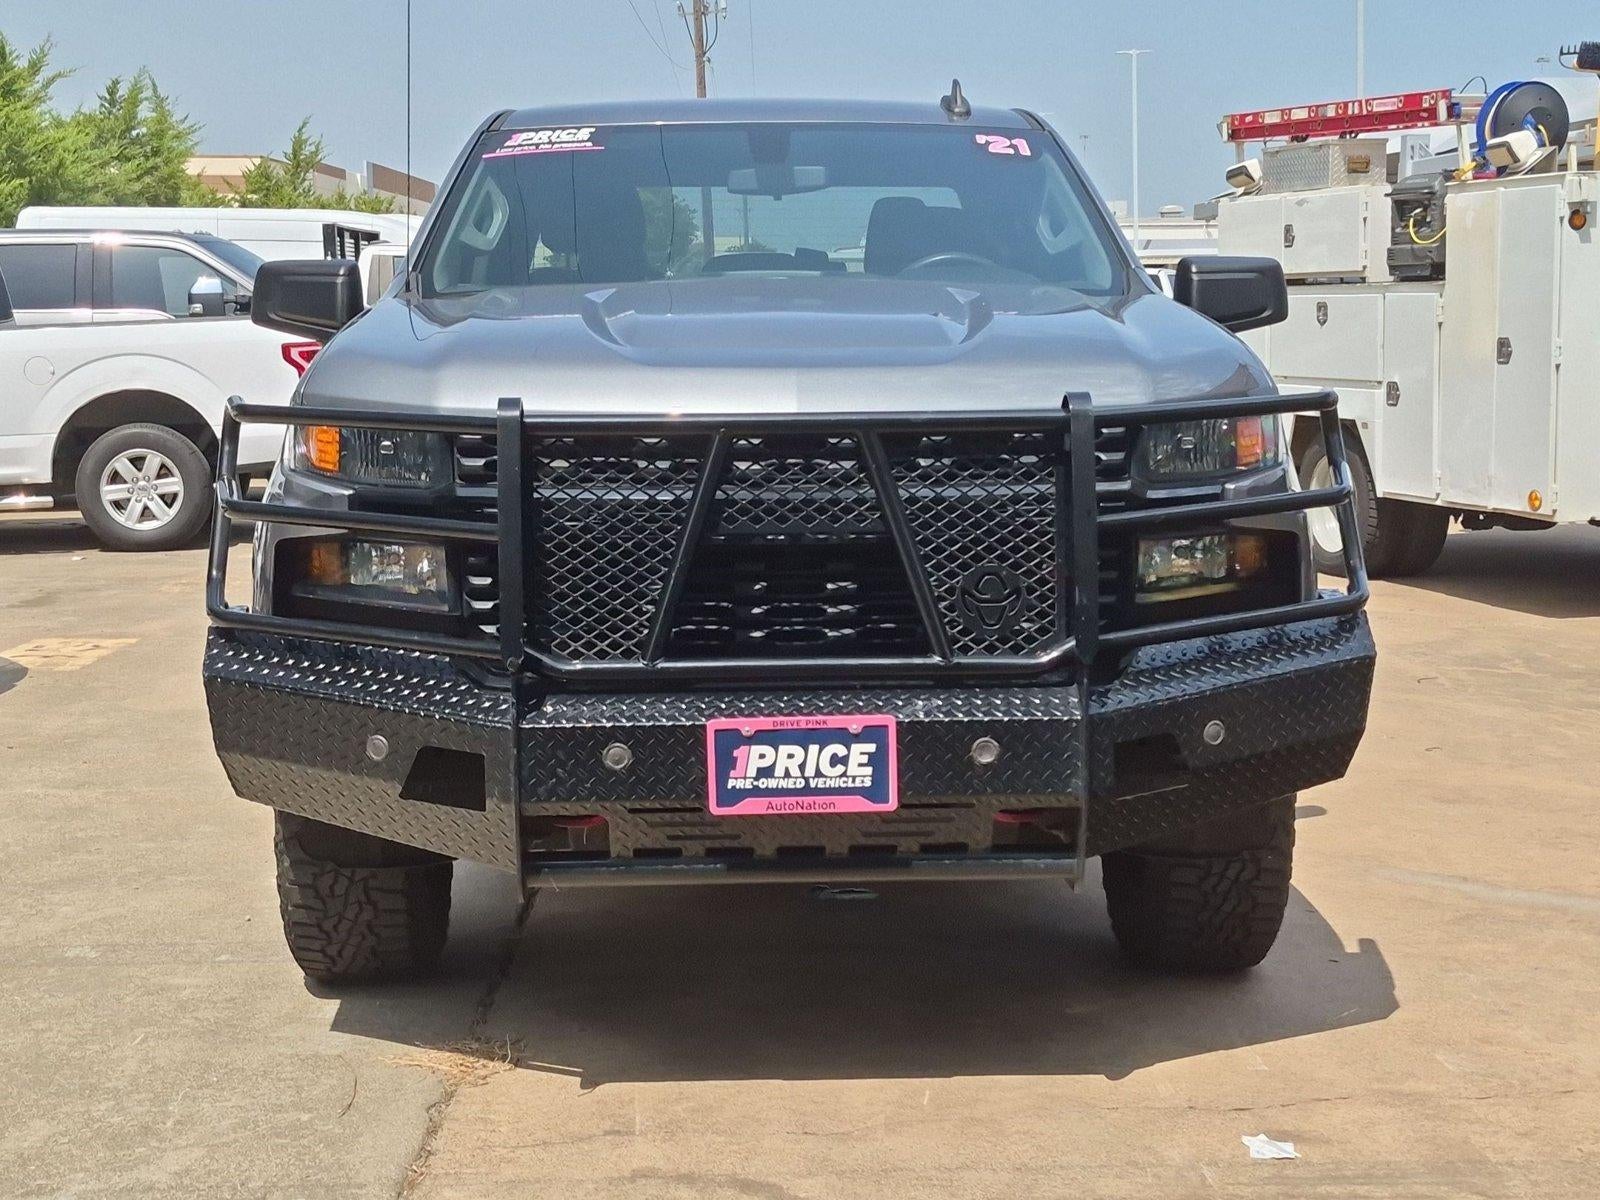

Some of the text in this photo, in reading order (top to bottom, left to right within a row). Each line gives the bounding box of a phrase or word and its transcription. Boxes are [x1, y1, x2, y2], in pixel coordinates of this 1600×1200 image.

[504, 127, 597, 147] 1PRICE
[975, 134, 1032, 156] '21
[772, 719, 829, 728] DRIVE PINK
[729, 743, 877, 778] 1PRICE
[727, 776, 873, 790] PRE-OWNED VEHICLES
[765, 800, 836, 812] AutoNation
